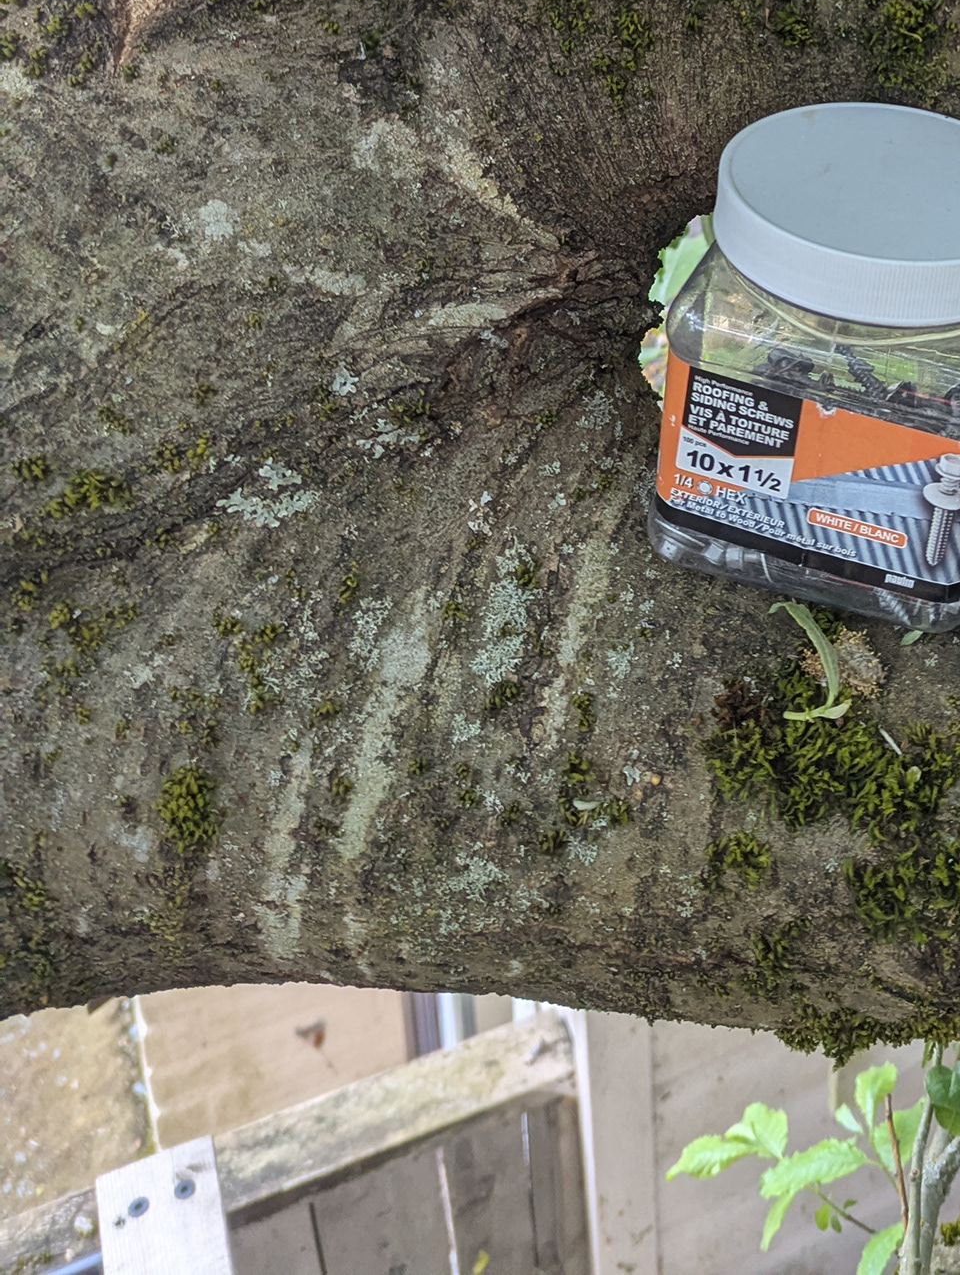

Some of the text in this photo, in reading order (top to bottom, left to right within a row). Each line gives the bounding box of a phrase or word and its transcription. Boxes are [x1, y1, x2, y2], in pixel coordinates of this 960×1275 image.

[692, 382, 769, 412] ROOFING &
[694, 375, 754, 397] High Performance
[690, 404, 790, 440] VIS À TOITURE
[691, 392, 795, 429] SIDING SCREWS
[688, 414, 784, 448] ET PAREMENT
[707, 429, 750, 446] Performance
[674, 473, 748, 505] 1/4 HEX
[686, 500, 714, 516] Metal
[715, 508, 727, 519] to
[816, 540, 834, 552] sur
[836, 545, 857, 558] bois
[815, 512, 852, 531] WHITE
[860, 525, 900, 543] BLANC
